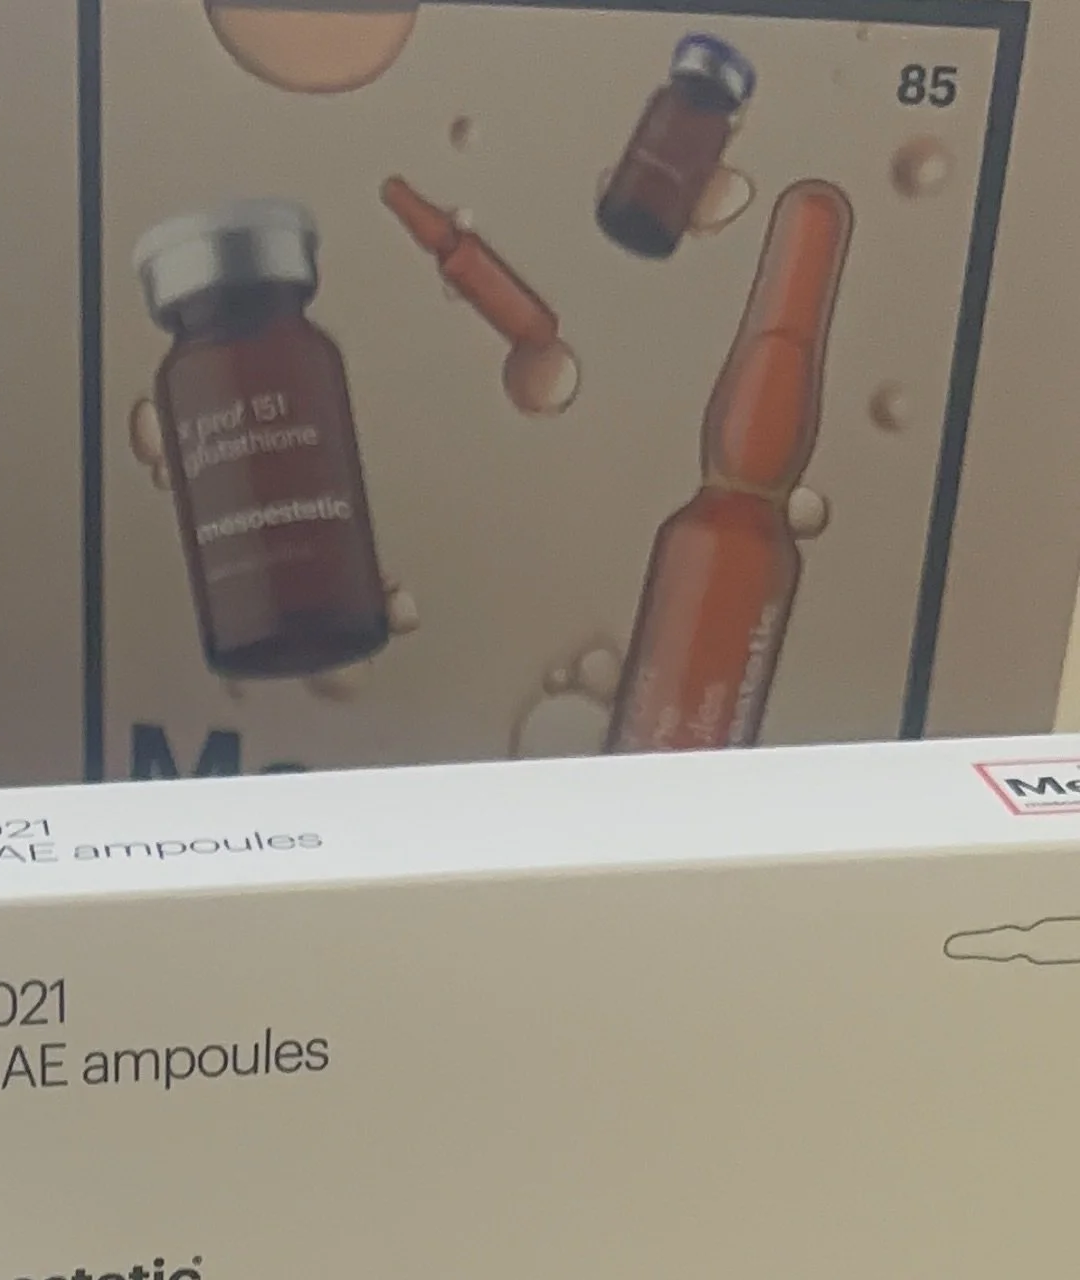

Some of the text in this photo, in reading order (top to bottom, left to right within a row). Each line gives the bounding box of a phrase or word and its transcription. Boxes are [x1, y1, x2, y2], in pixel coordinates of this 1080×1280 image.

[897, 63, 957, 108] 85
[130, 723, 307, 778] M
[72, 828, 323, 861] ampoules
[81, 1028, 329, 1089] ampoules
